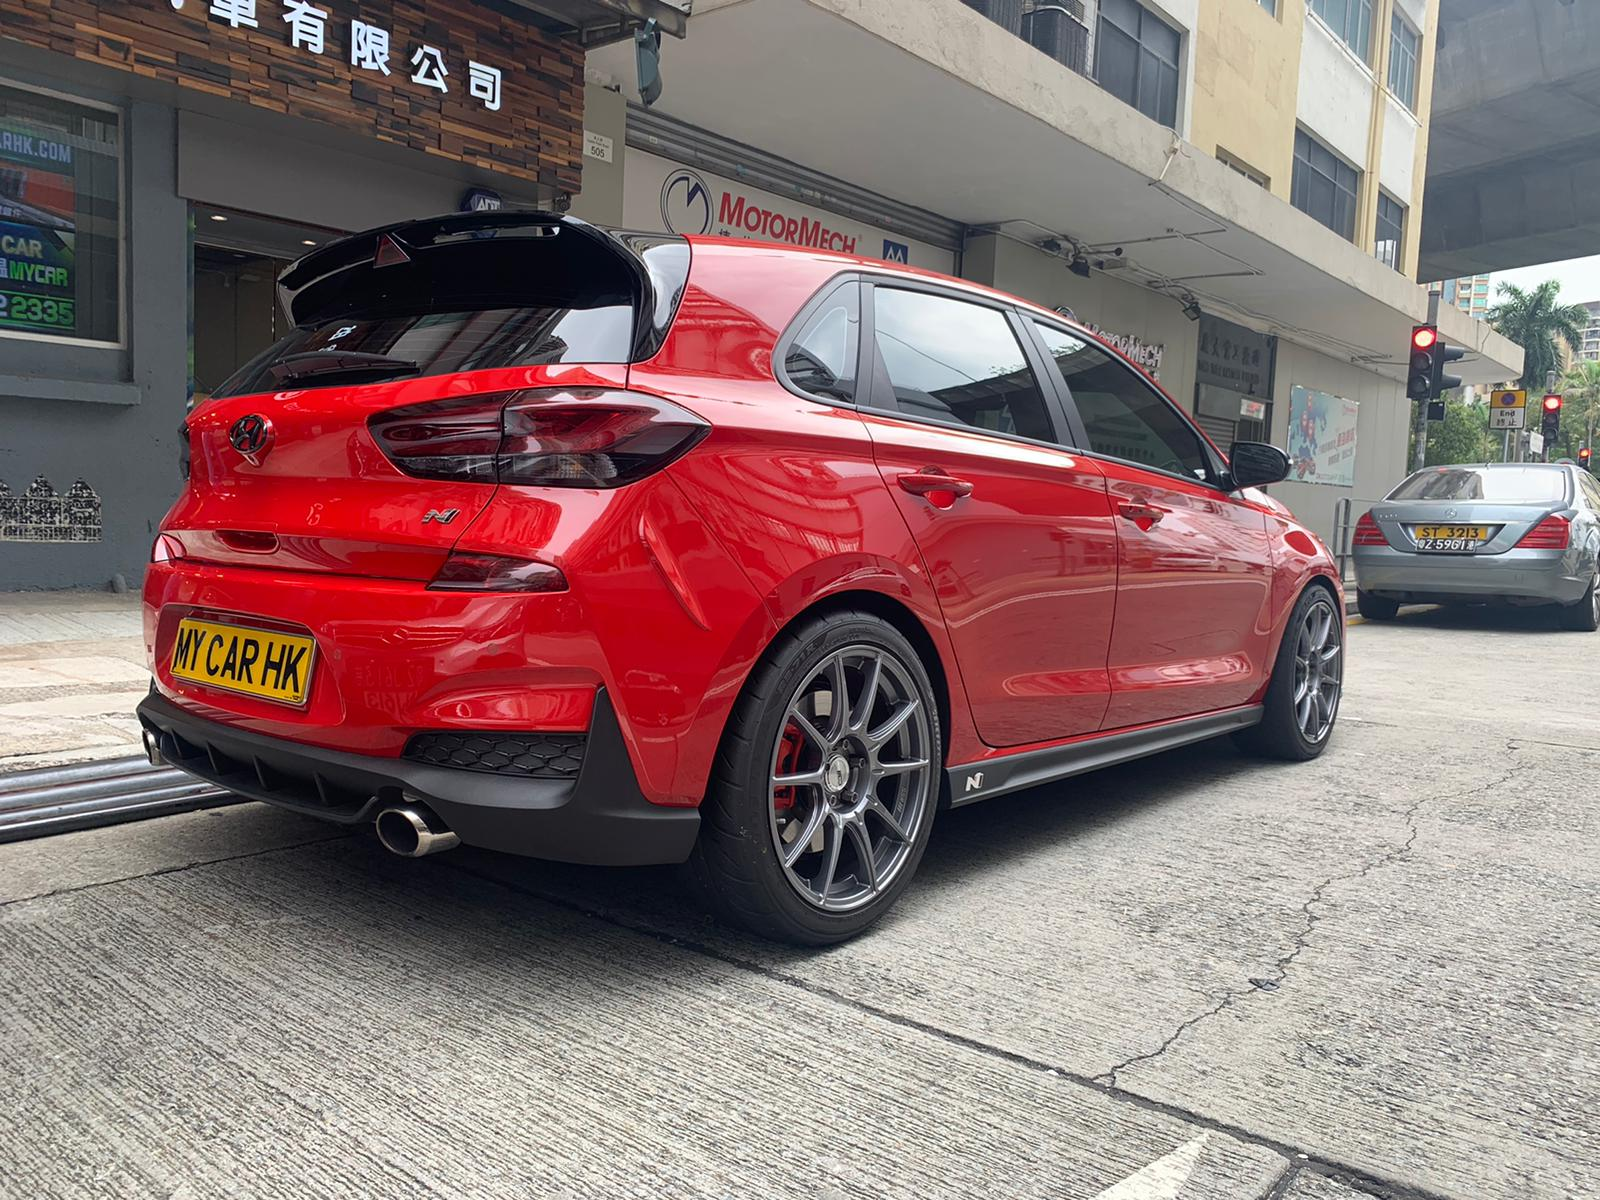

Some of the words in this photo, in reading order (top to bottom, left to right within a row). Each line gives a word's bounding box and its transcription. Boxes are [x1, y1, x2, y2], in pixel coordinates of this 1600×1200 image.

[171, 0, 502, 111] 車有限公司
[0, 132, 72, 164] RHK.COM
[591, 145, 605, 159] 505
[10, 296, 74, 326] 2335
[1500, 410, 1516, 418] End
[1422, 527, 1440, 538] ST
[1446, 527, 1479, 538] 3213
[172, 627, 207, 672] MY
[205, 633, 260, 685] CAR
[260, 641, 308, 694] HK
